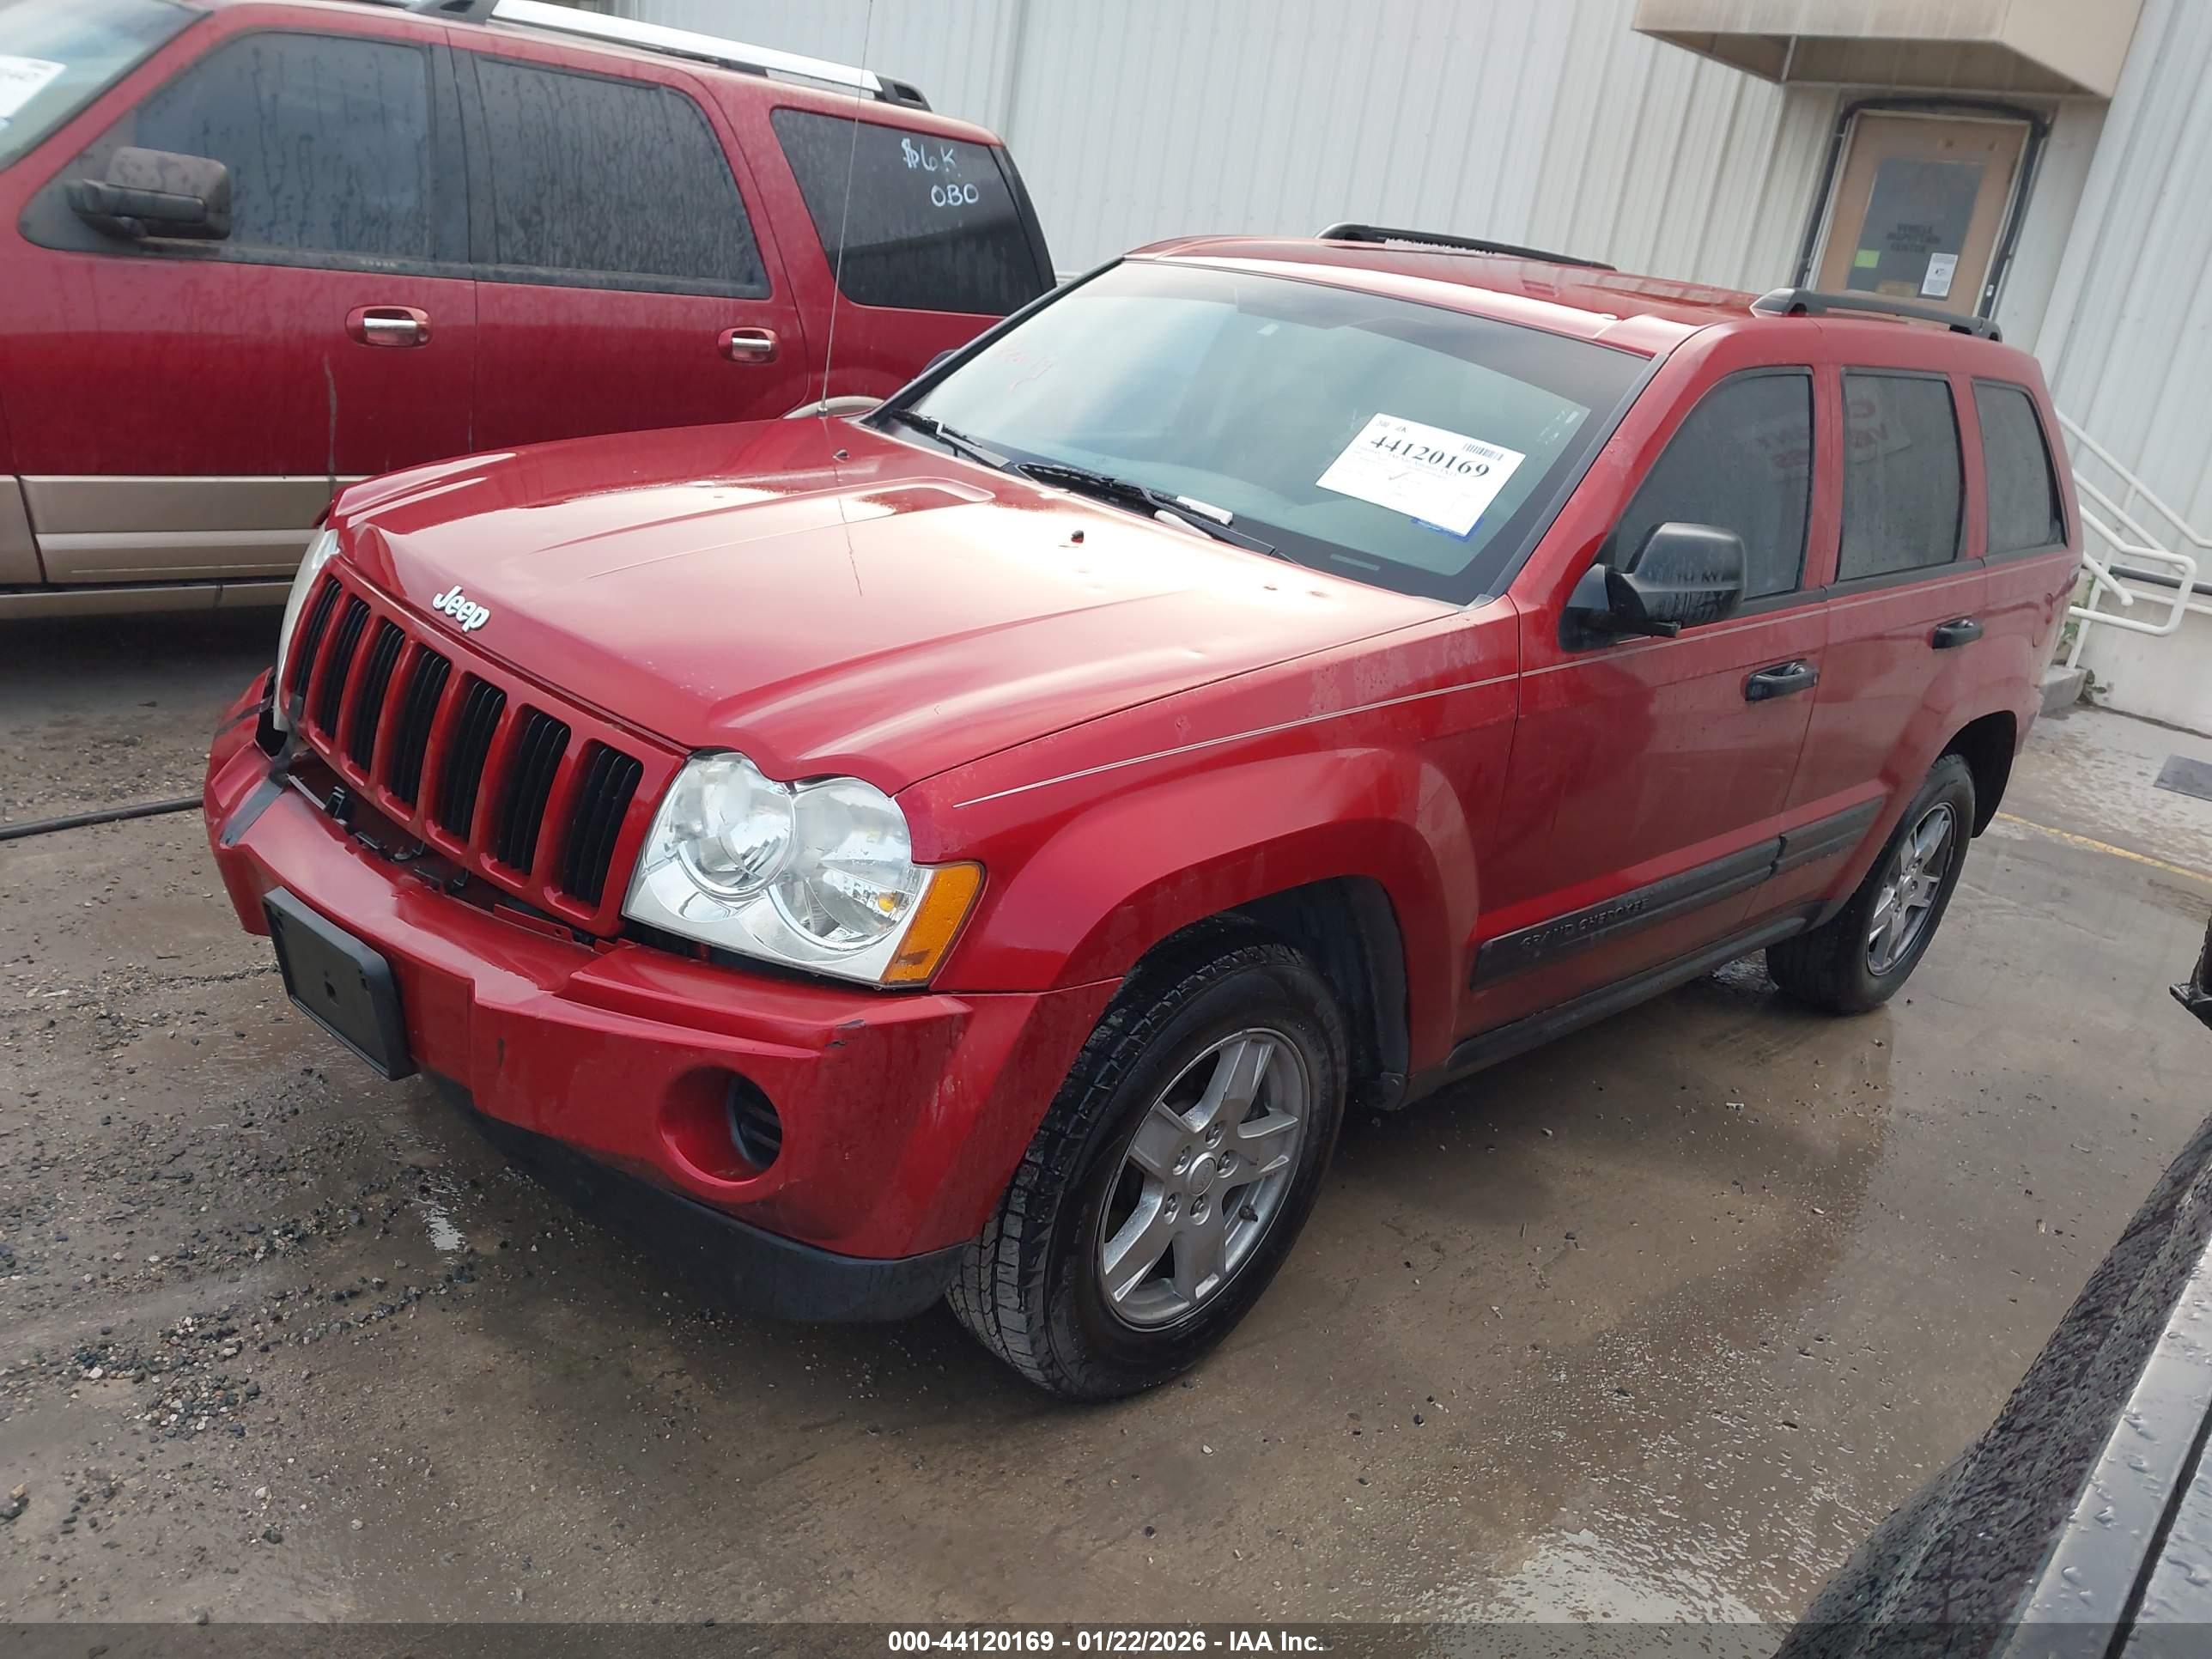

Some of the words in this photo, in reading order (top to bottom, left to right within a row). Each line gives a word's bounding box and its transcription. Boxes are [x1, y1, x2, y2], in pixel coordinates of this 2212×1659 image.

[930, 182, 980, 208] OBO
[1370, 434, 1491, 478] 44120169
[432, 584, 491, 633] Jeep
[1520, 923, 1574, 947] GRAND
[1578, 897, 1650, 930] CHEROKEE
